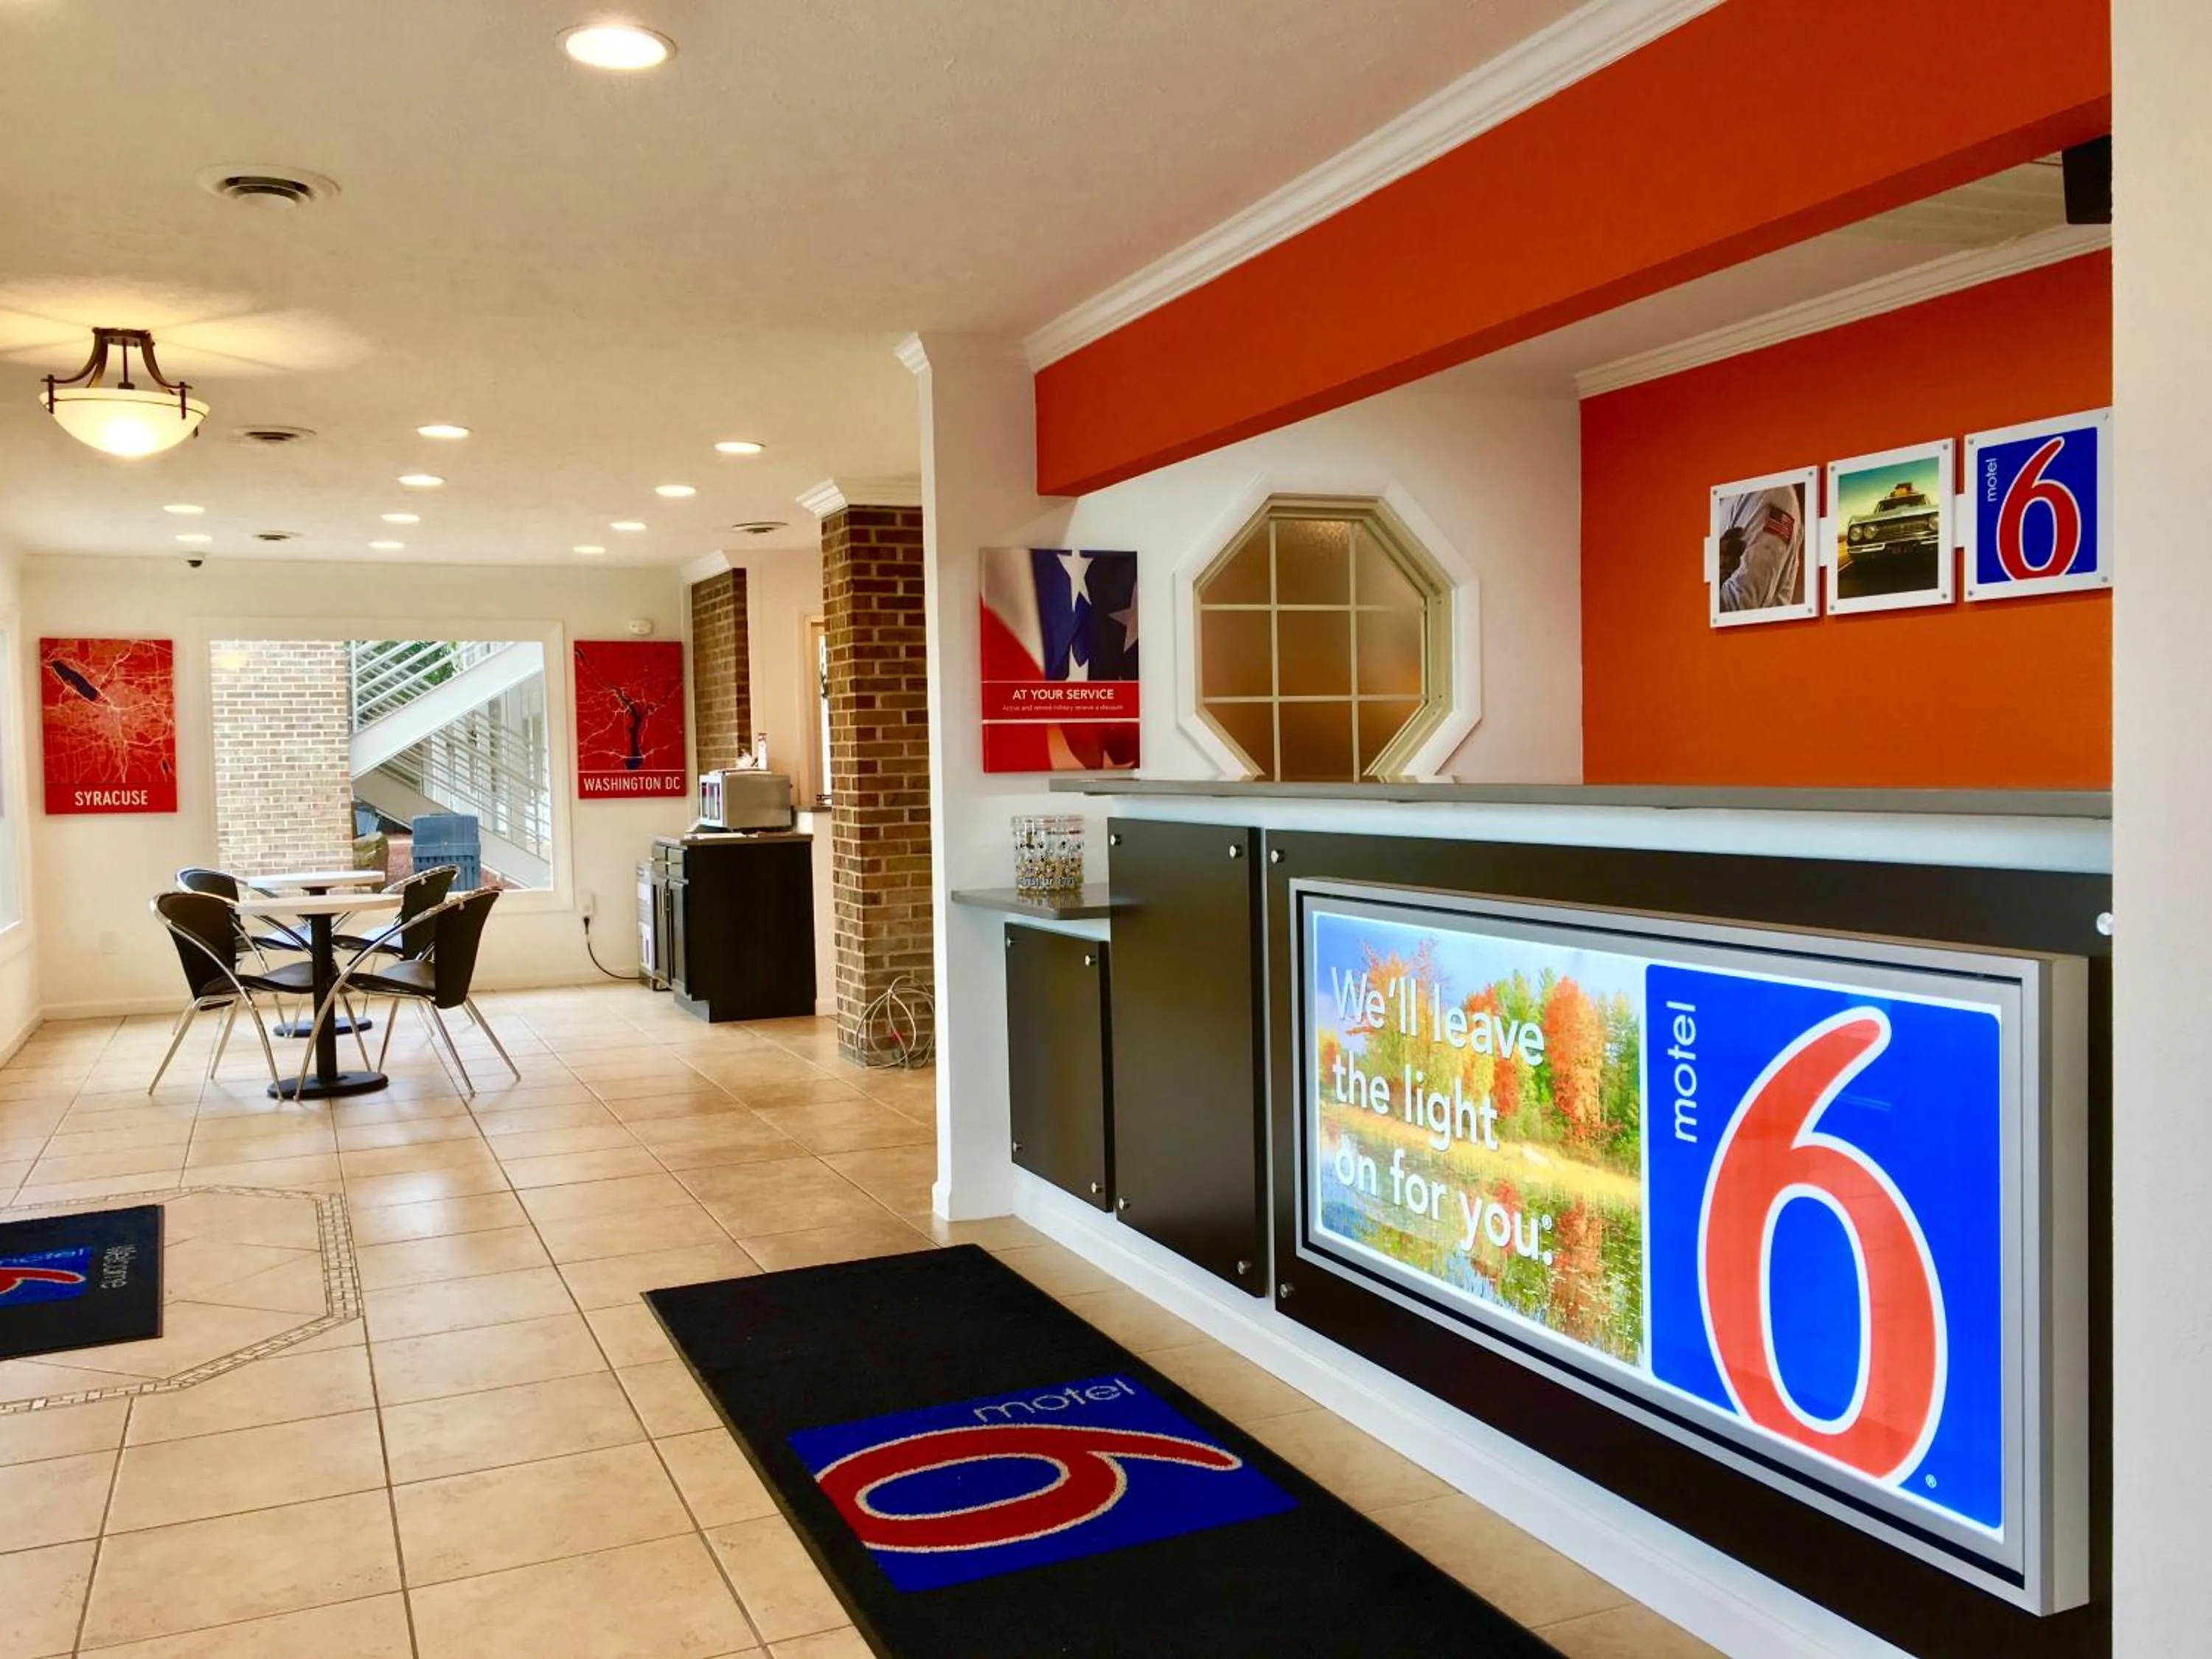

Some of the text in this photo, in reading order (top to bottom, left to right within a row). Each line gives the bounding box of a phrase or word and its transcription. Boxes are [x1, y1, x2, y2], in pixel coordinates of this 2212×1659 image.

[1985, 457, 1997, 502] motel
[1996, 436, 2081, 581] 6
[1012, 689, 1114, 700] AT YOUR SERVICE
[74, 790, 148, 806] SYRACUSE
[584, 776, 681, 791] WASHINGTON DC
[1331, 967, 1545, 1065] We'll leave
[1332, 1054, 1498, 1151] the light
[1666, 1000, 1698, 1144] motel
[1335, 1147, 1378, 1198] on
[1389, 1147, 1445, 1220] for
[1697, 1006, 1948, 1489] 6
[973, 1377, 1136, 1424] motel
[813, 1422, 1243, 1554] 6
